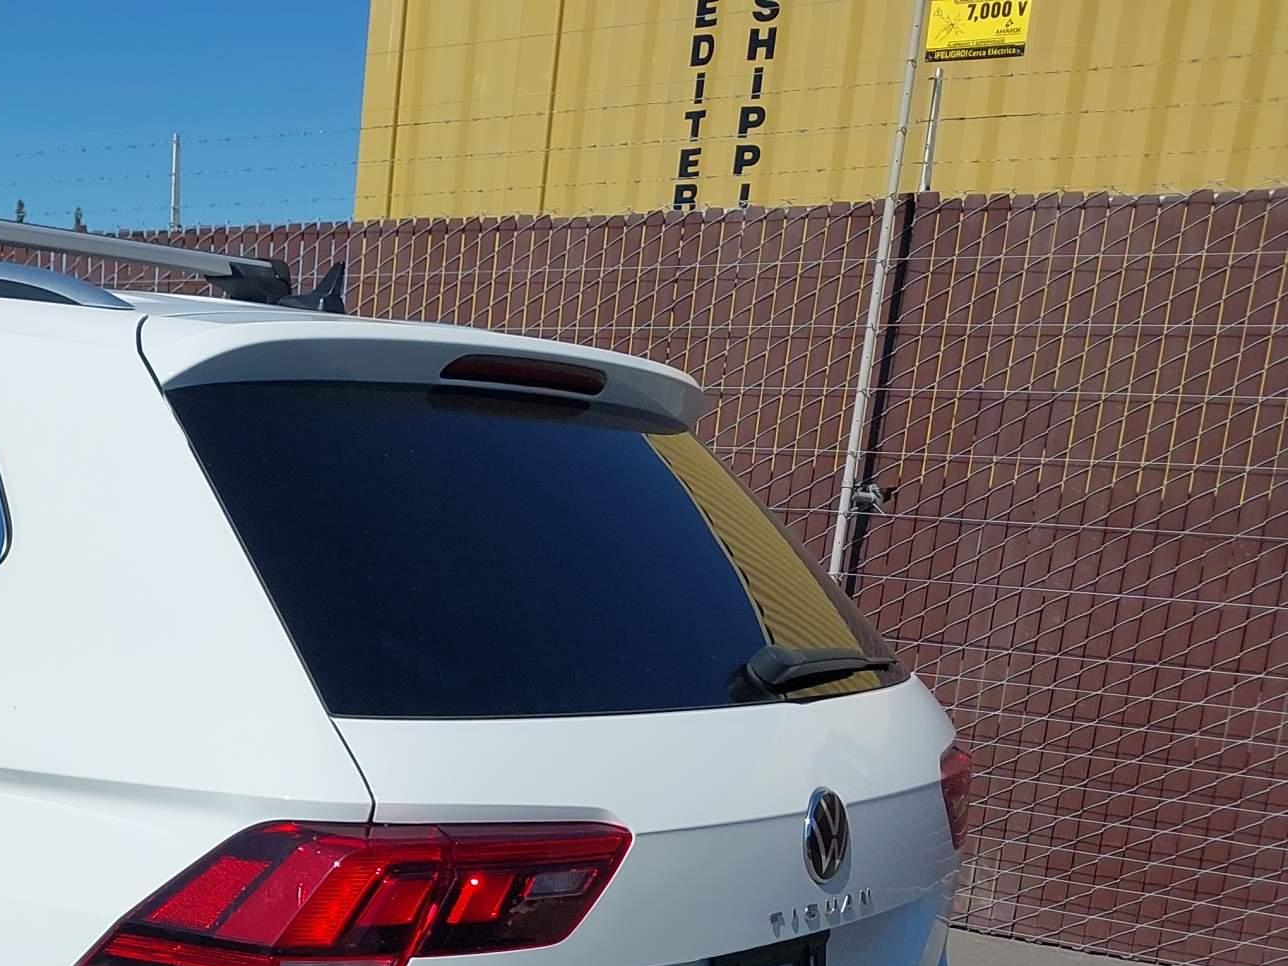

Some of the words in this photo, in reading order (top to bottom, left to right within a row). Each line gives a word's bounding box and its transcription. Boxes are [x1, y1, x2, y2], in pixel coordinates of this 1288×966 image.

[967, 1, 1012, 22] 7,000
[1018, 1, 1028, 16] V
[987, 46, 1016, 56] Eléctrica
[768, 887, 872, 924] TIGUAN
